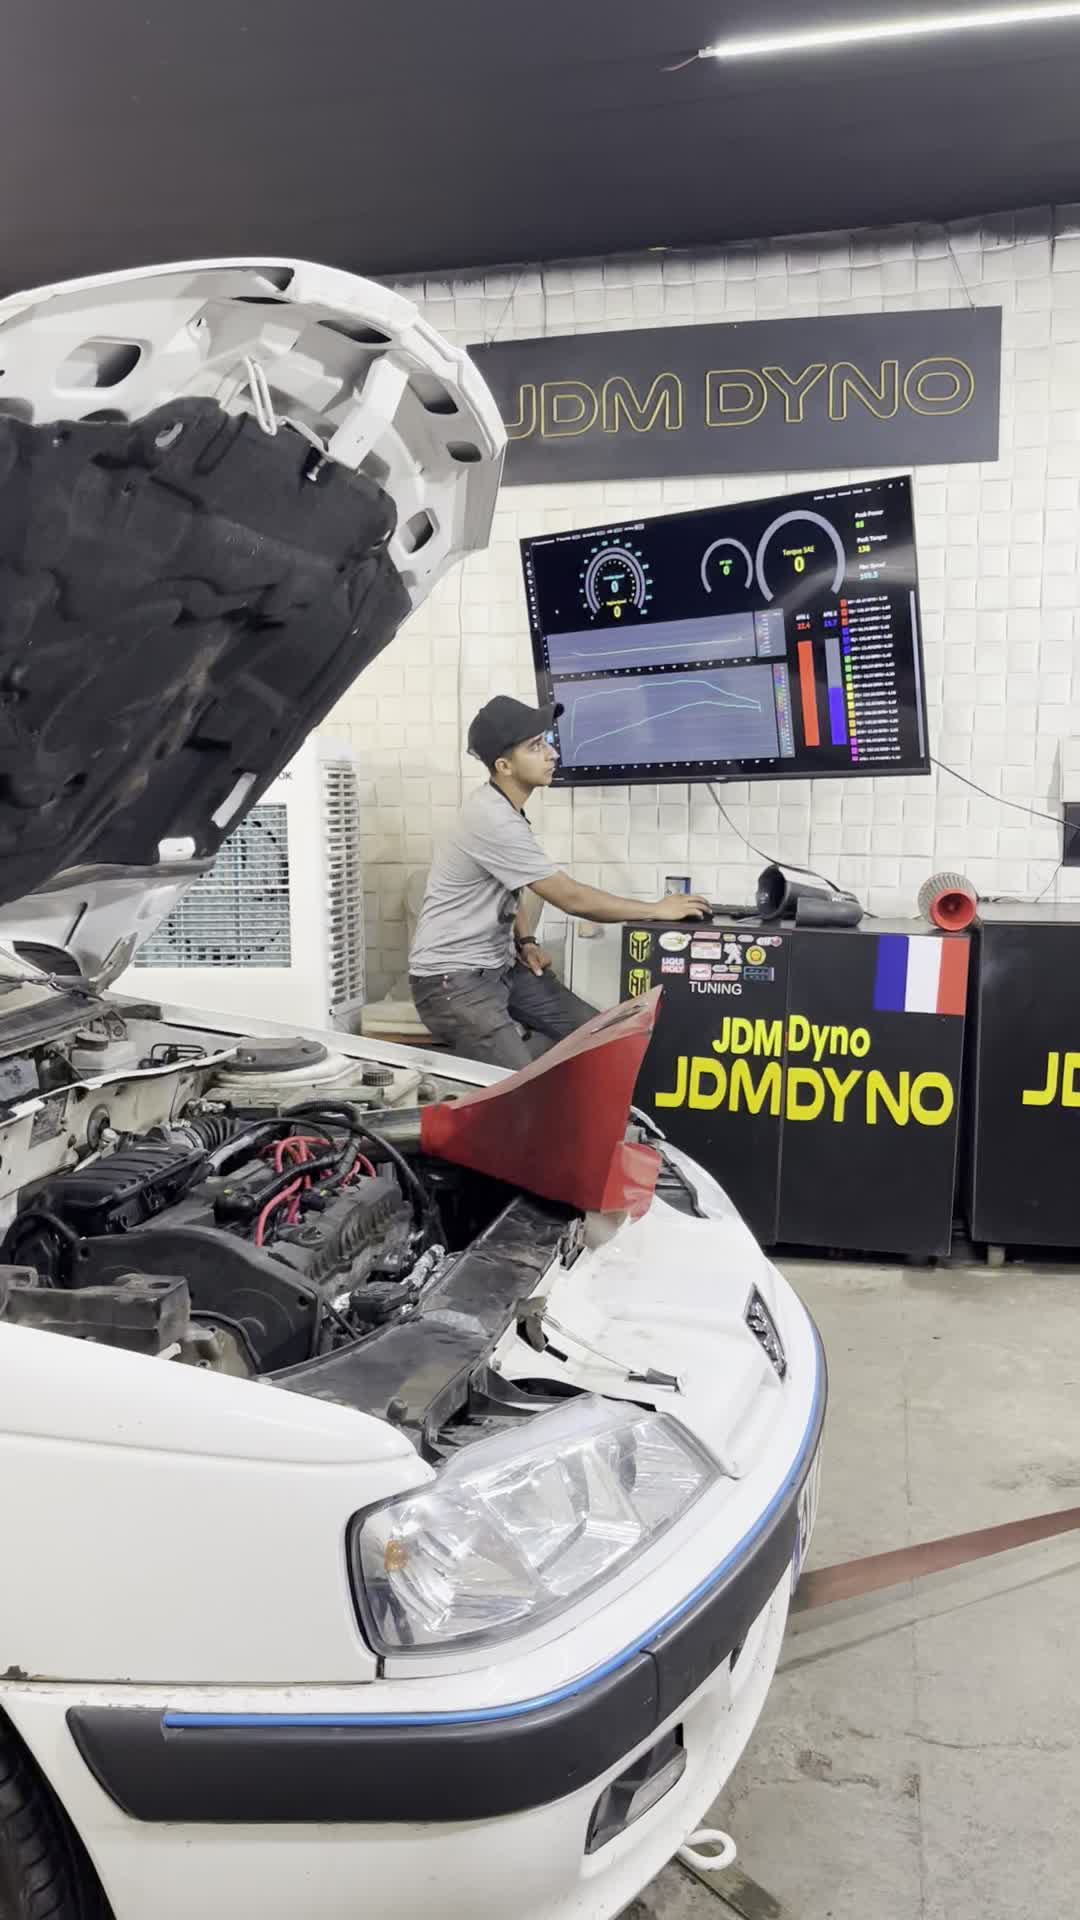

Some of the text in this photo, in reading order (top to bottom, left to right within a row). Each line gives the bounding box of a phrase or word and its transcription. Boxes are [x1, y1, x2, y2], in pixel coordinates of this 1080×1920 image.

[504, 357, 975, 440] JDM DYNO
[723, 565, 730, 576] 0
[794, 556, 805, 572] 0
[611, 580, 619, 593] 0
[613, 605, 621, 618] 0
[689, 980, 742, 996] TUNING
[712, 1014, 871, 1062] JDM Dyno
